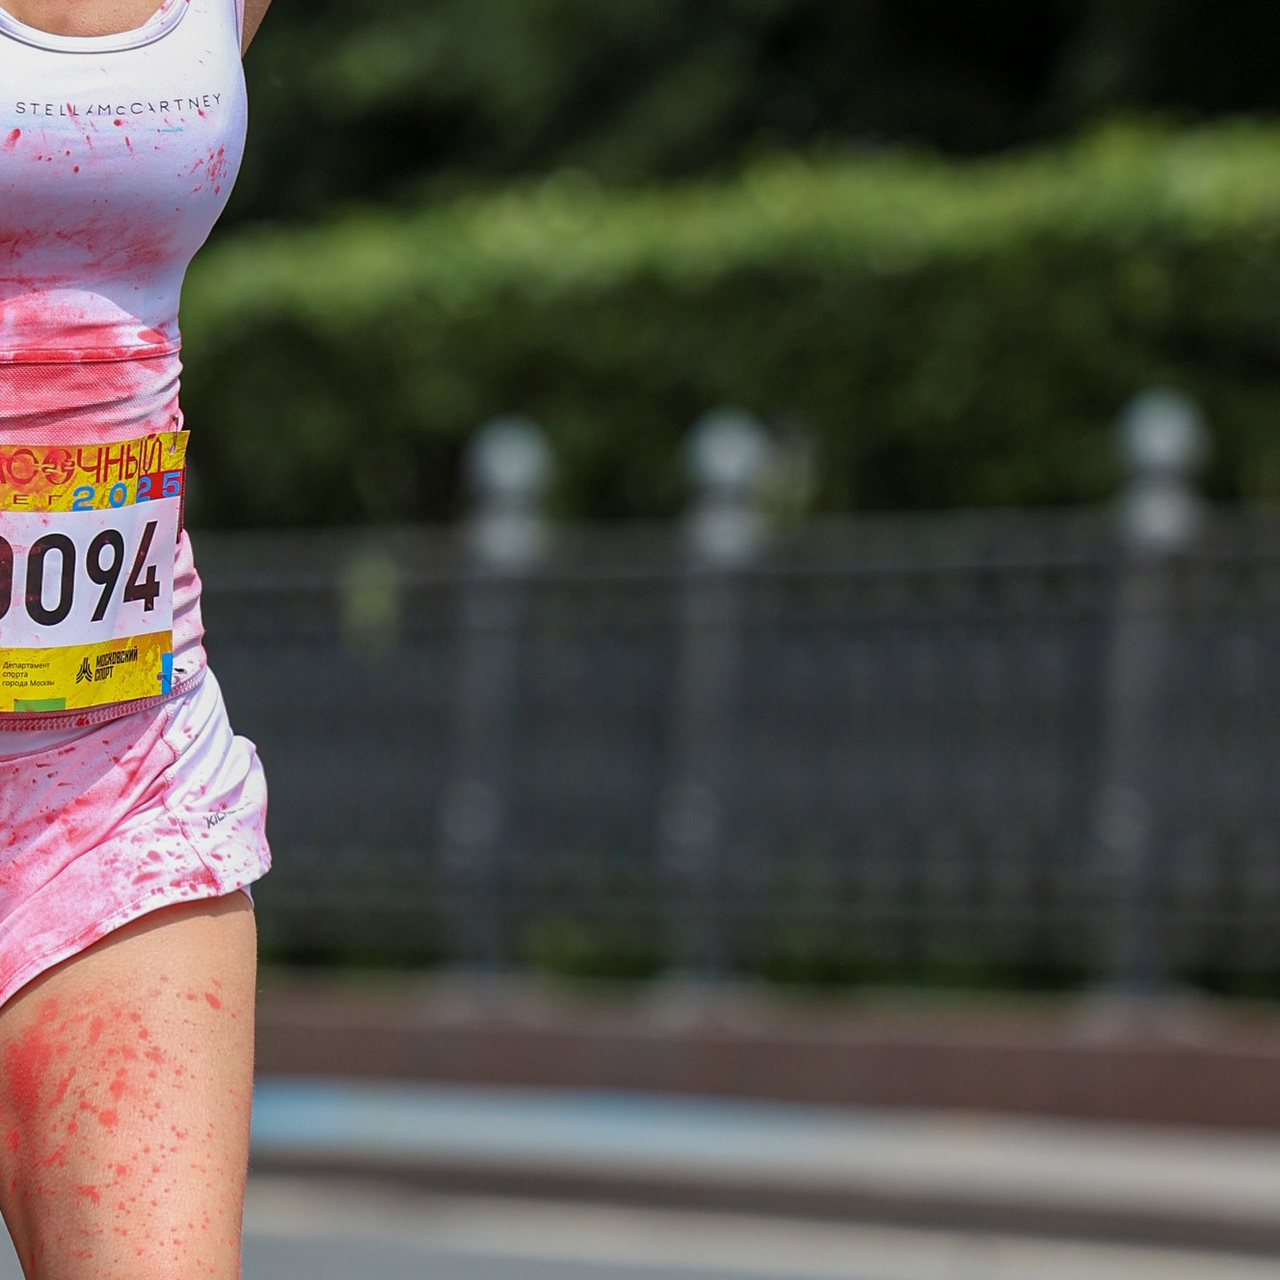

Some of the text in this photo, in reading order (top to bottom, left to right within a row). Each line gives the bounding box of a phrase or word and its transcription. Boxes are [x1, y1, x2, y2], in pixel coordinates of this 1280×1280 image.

[72, 472, 180, 511] 2025
[2, 671, 29, 679] спорта
[2, 680, 29, 688] города
